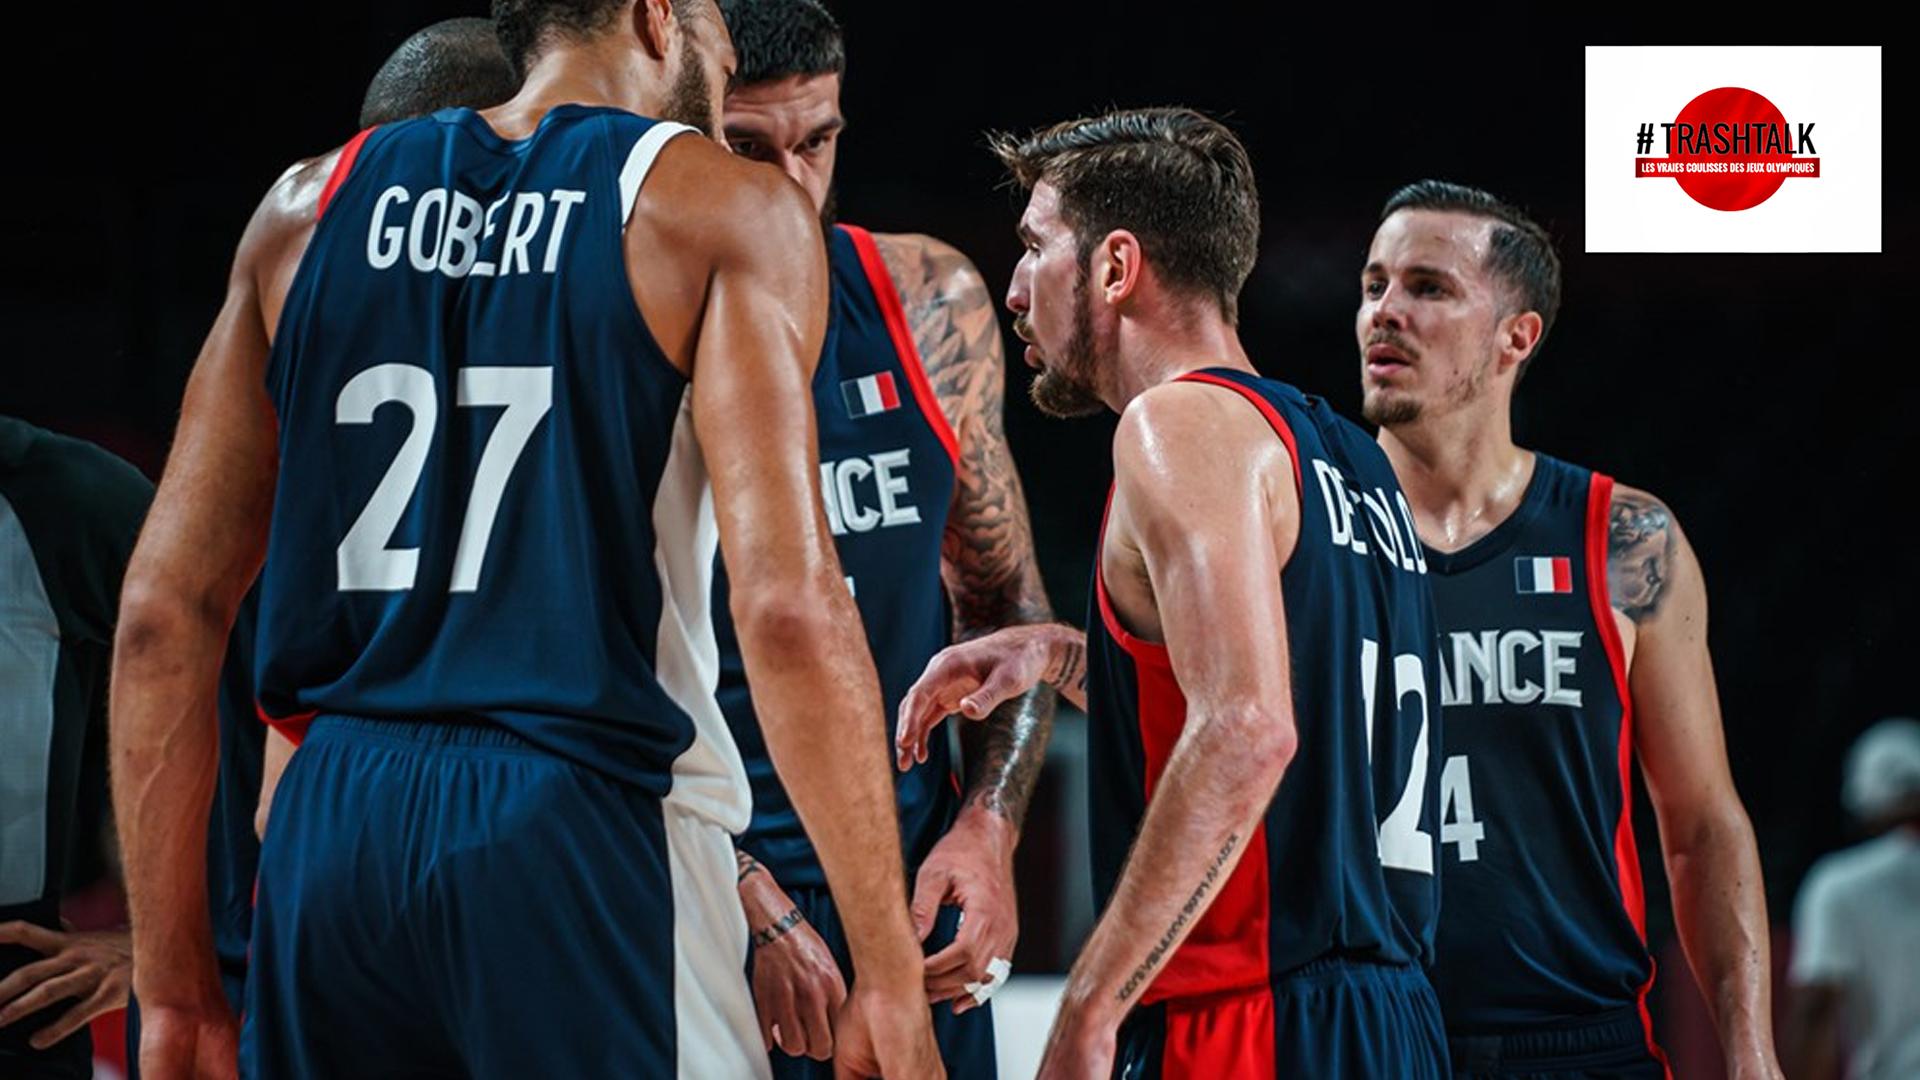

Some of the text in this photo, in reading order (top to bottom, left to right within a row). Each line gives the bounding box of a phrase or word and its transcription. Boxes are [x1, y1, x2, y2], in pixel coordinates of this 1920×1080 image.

[367, 186, 586, 279] GOBERT
[336, 363, 554, 593] 27
[1361, 638, 1434, 875] 12
